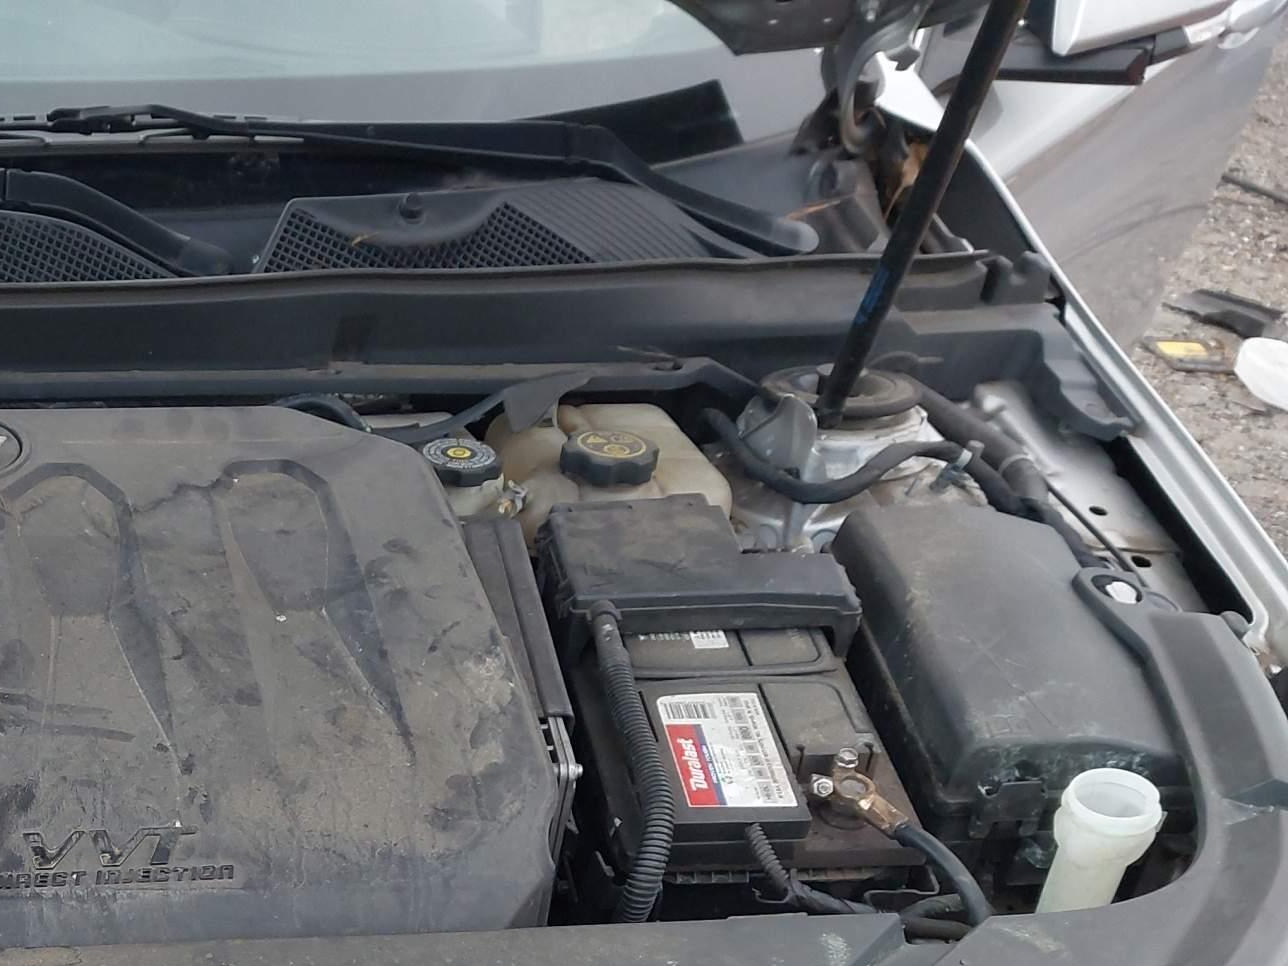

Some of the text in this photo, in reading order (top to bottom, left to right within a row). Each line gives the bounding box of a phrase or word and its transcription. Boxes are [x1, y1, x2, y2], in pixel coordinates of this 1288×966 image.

[677, 738, 709, 791] Duralast
[22, 826, 199, 870] VVT
[95, 864, 235, 886] INJECTION
